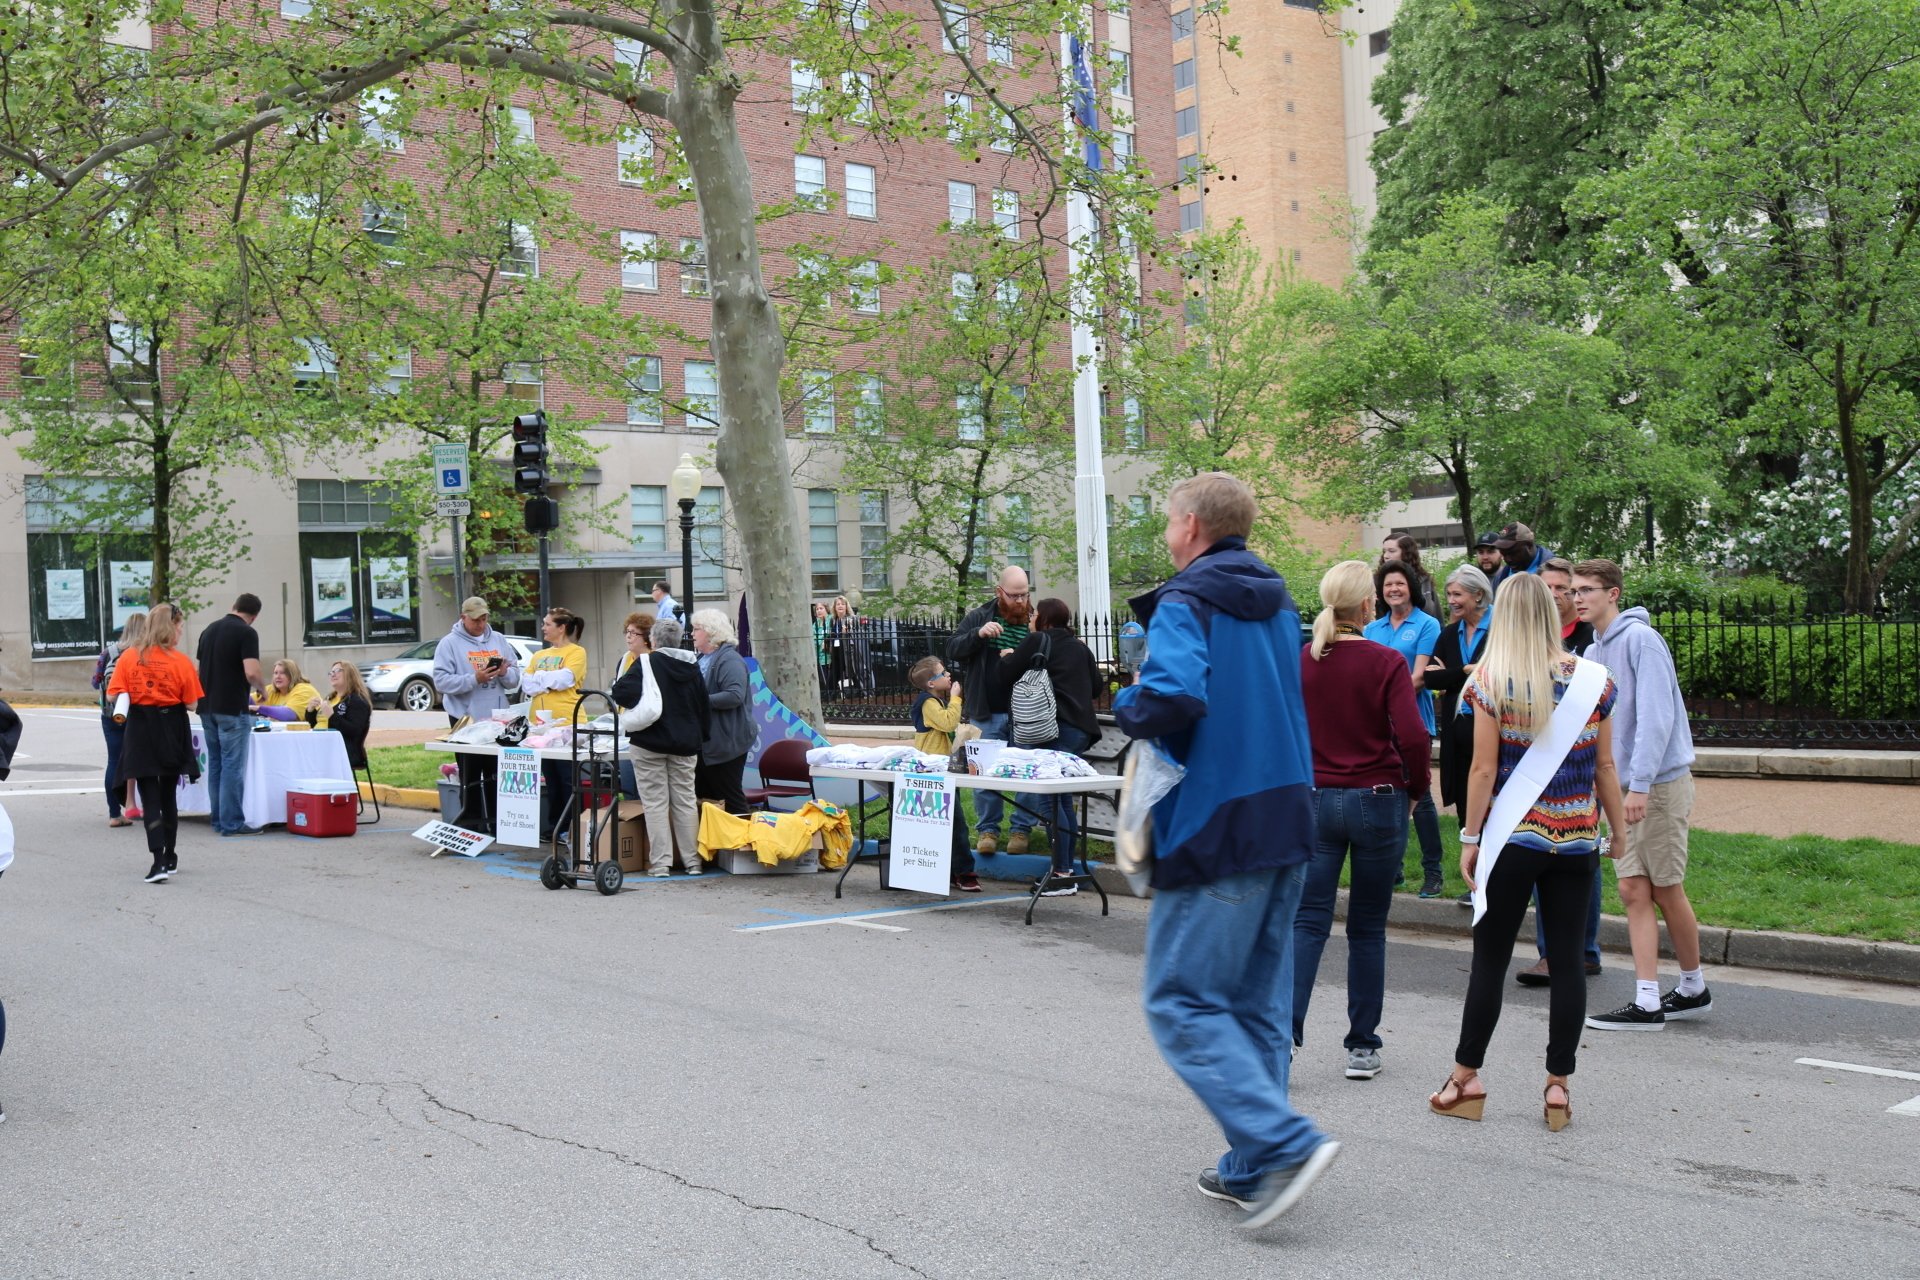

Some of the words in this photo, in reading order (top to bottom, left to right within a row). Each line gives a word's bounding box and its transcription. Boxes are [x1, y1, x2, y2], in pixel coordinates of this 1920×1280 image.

[435, 448, 464, 456] RESERVED
[438, 457, 463, 465] PARKING
[438, 501, 468, 509] $50-$300
[967, 744, 980, 756] ite
[504, 752, 535, 761] REGISTER
[500, 762, 517, 770] YOUR
[519, 763, 538, 772] TEAM!
[905, 778, 945, 790] T-SHIRTS
[507, 811, 516, 819] Try
[512, 820, 519, 828] of
[518, 820, 536, 830] Shoes!
[432, 830, 474, 846] ENOUGH
[441, 825, 459, 835] AM
[458, 831, 484, 842] MAN
[424, 834, 439, 842] TO
[439, 839, 469, 852] WALK
[902, 845, 911, 854] 10
[912, 846, 940, 857] Tickets
[903, 858, 916, 866] per
[917, 858, 937, 868] Shirt
